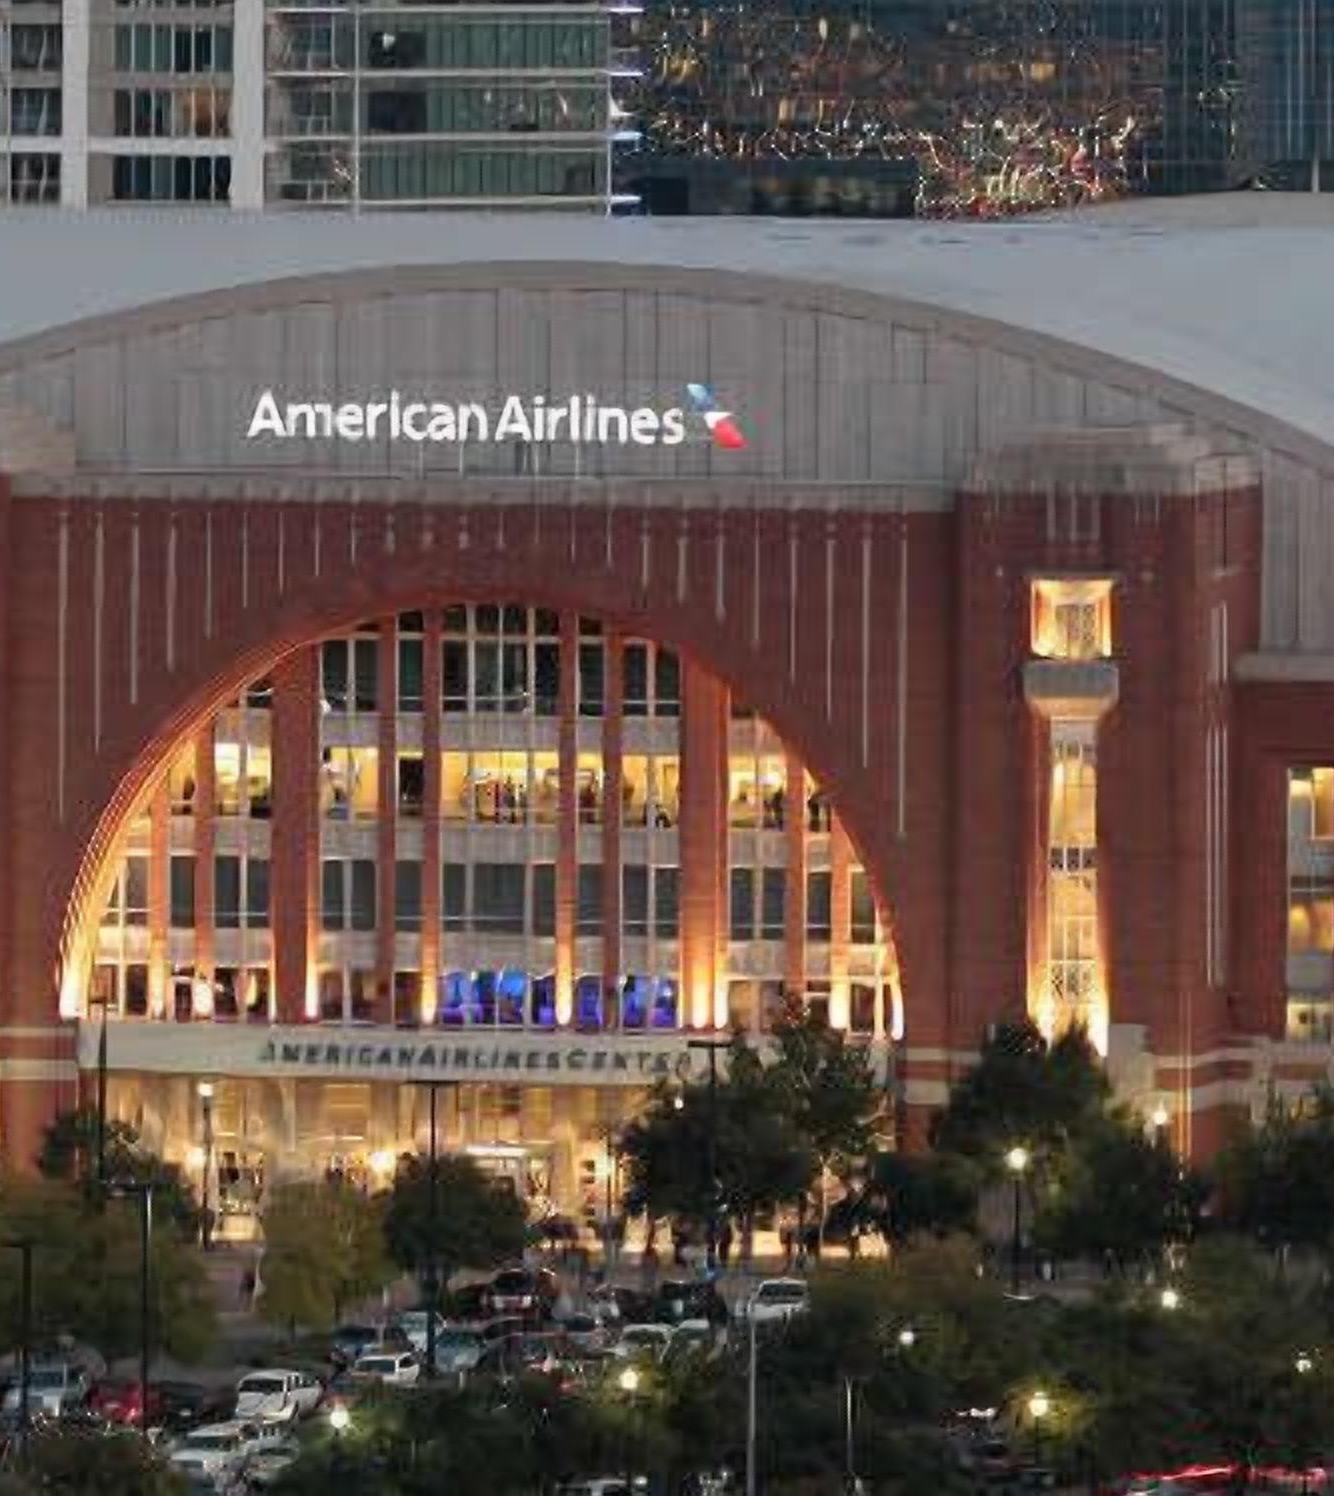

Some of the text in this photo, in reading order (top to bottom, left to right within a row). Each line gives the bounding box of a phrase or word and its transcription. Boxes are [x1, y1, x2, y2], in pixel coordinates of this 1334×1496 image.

[247, 391, 684, 444] American Airlines
[259, 1040, 415, 1066] AMERICAN
[418, 1044, 560, 1069] AIRLINES
